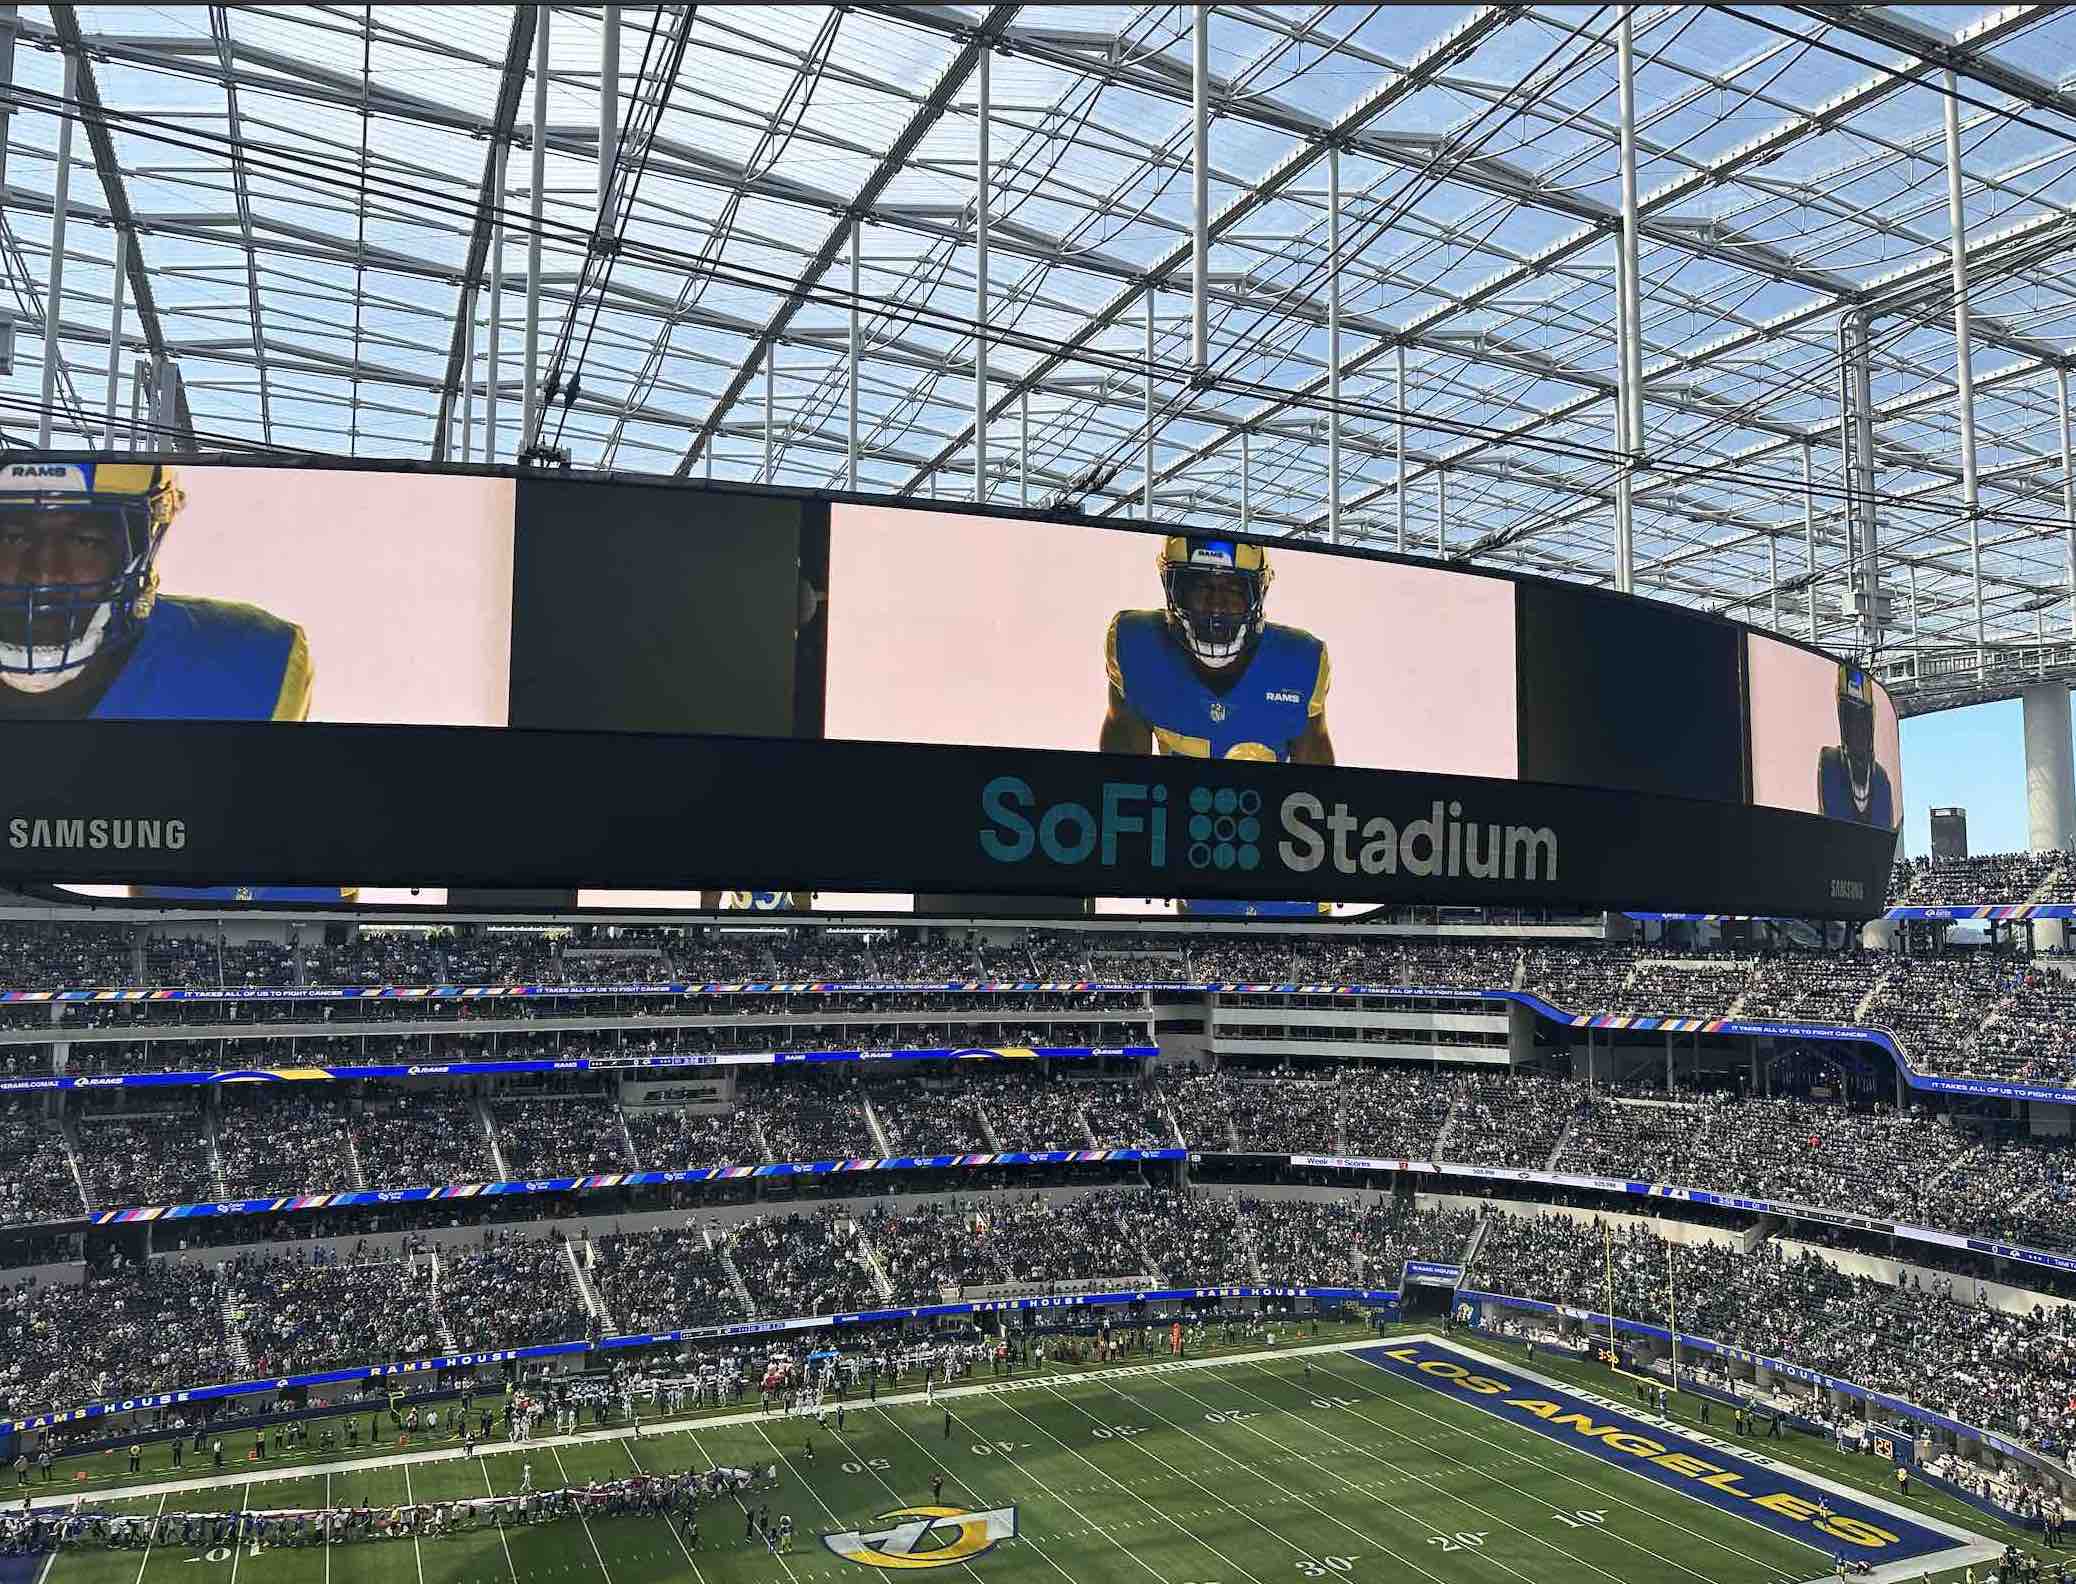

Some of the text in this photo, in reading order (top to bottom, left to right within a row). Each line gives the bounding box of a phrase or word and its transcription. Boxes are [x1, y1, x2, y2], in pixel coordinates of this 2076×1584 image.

[12, 467, 66, 477] RAMS
[1266, 692, 1300, 703] RAMS
[9, 818, 186, 849] SAMSUNG
[979, 776, 1559, 881] SoFi Stadium
[1940, 1082, 1968, 1091] TAKES
[1968, 1085, 1986, 1093] ALL
[1986, 1086, 2000, 1094] OF
[2014, 1089, 2027, 1097] TO
[2027, 1090, 2054, 1100] FIGHT
[1196, 1288, 1307, 1298] RAMS HOUSE
[972, 1297, 1084, 1312] RAMS HOUSE
[370, 1351, 517, 1376] RAMS HOUSE
[1775, 1362, 1834, 1388] HOUSE
[14, 1392, 189, 1432] RAMS HOUSE
[1204, 1410, 1250, 1425] 20
[1092, 1425, 1138, 1439] 30
[1548, 1382, 1776, 1466] IT TAKES ALL OF US
[971, 1440, 1016, 1457] 40
[1384, 1349, 1901, 1549] LOS ANGELES
[841, 1458, 891, 1475] 50
[1552, 1510, 1605, 1528] 10
[1426, 1532, 1484, 1552] 20
[1295, 1556, 1353, 1578] 30
